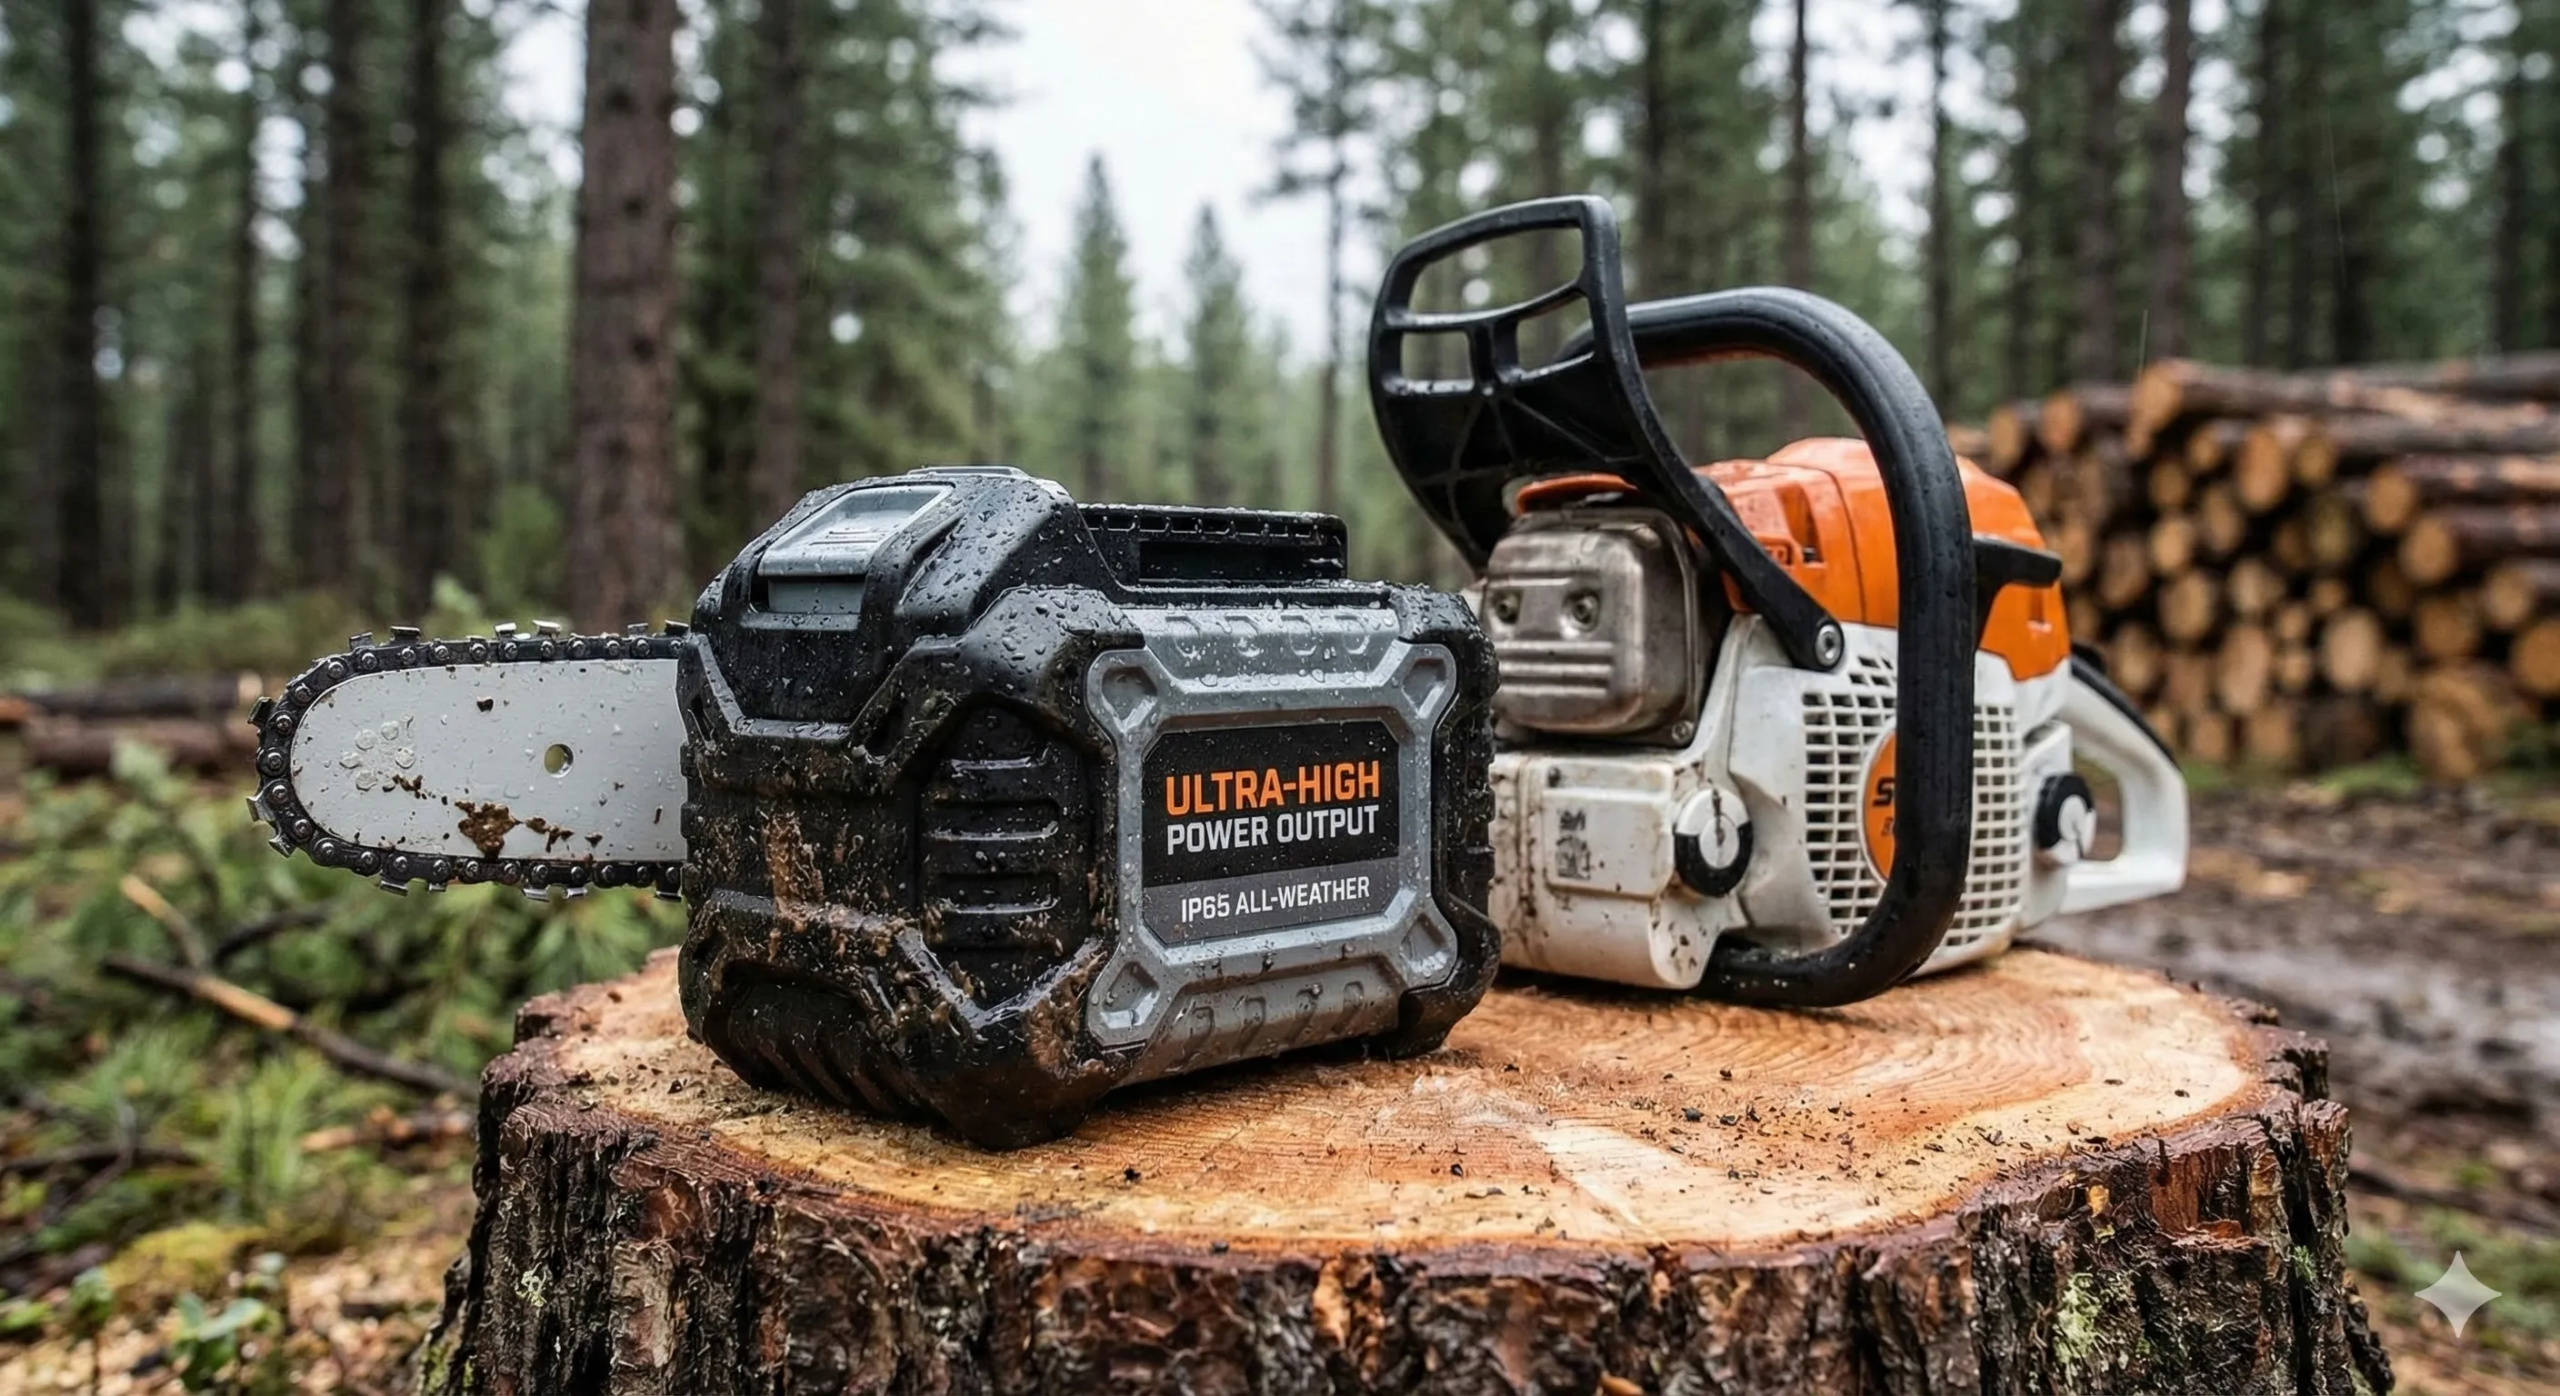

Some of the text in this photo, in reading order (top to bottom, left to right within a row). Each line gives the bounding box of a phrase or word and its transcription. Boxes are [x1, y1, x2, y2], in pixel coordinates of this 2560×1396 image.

[1165, 760, 1380, 816] ULTRA-HIGH
[1166, 804, 1380, 855] POWER OUTPUT
[1181, 876, 1370, 923] IP65 ALL-WEATHER
